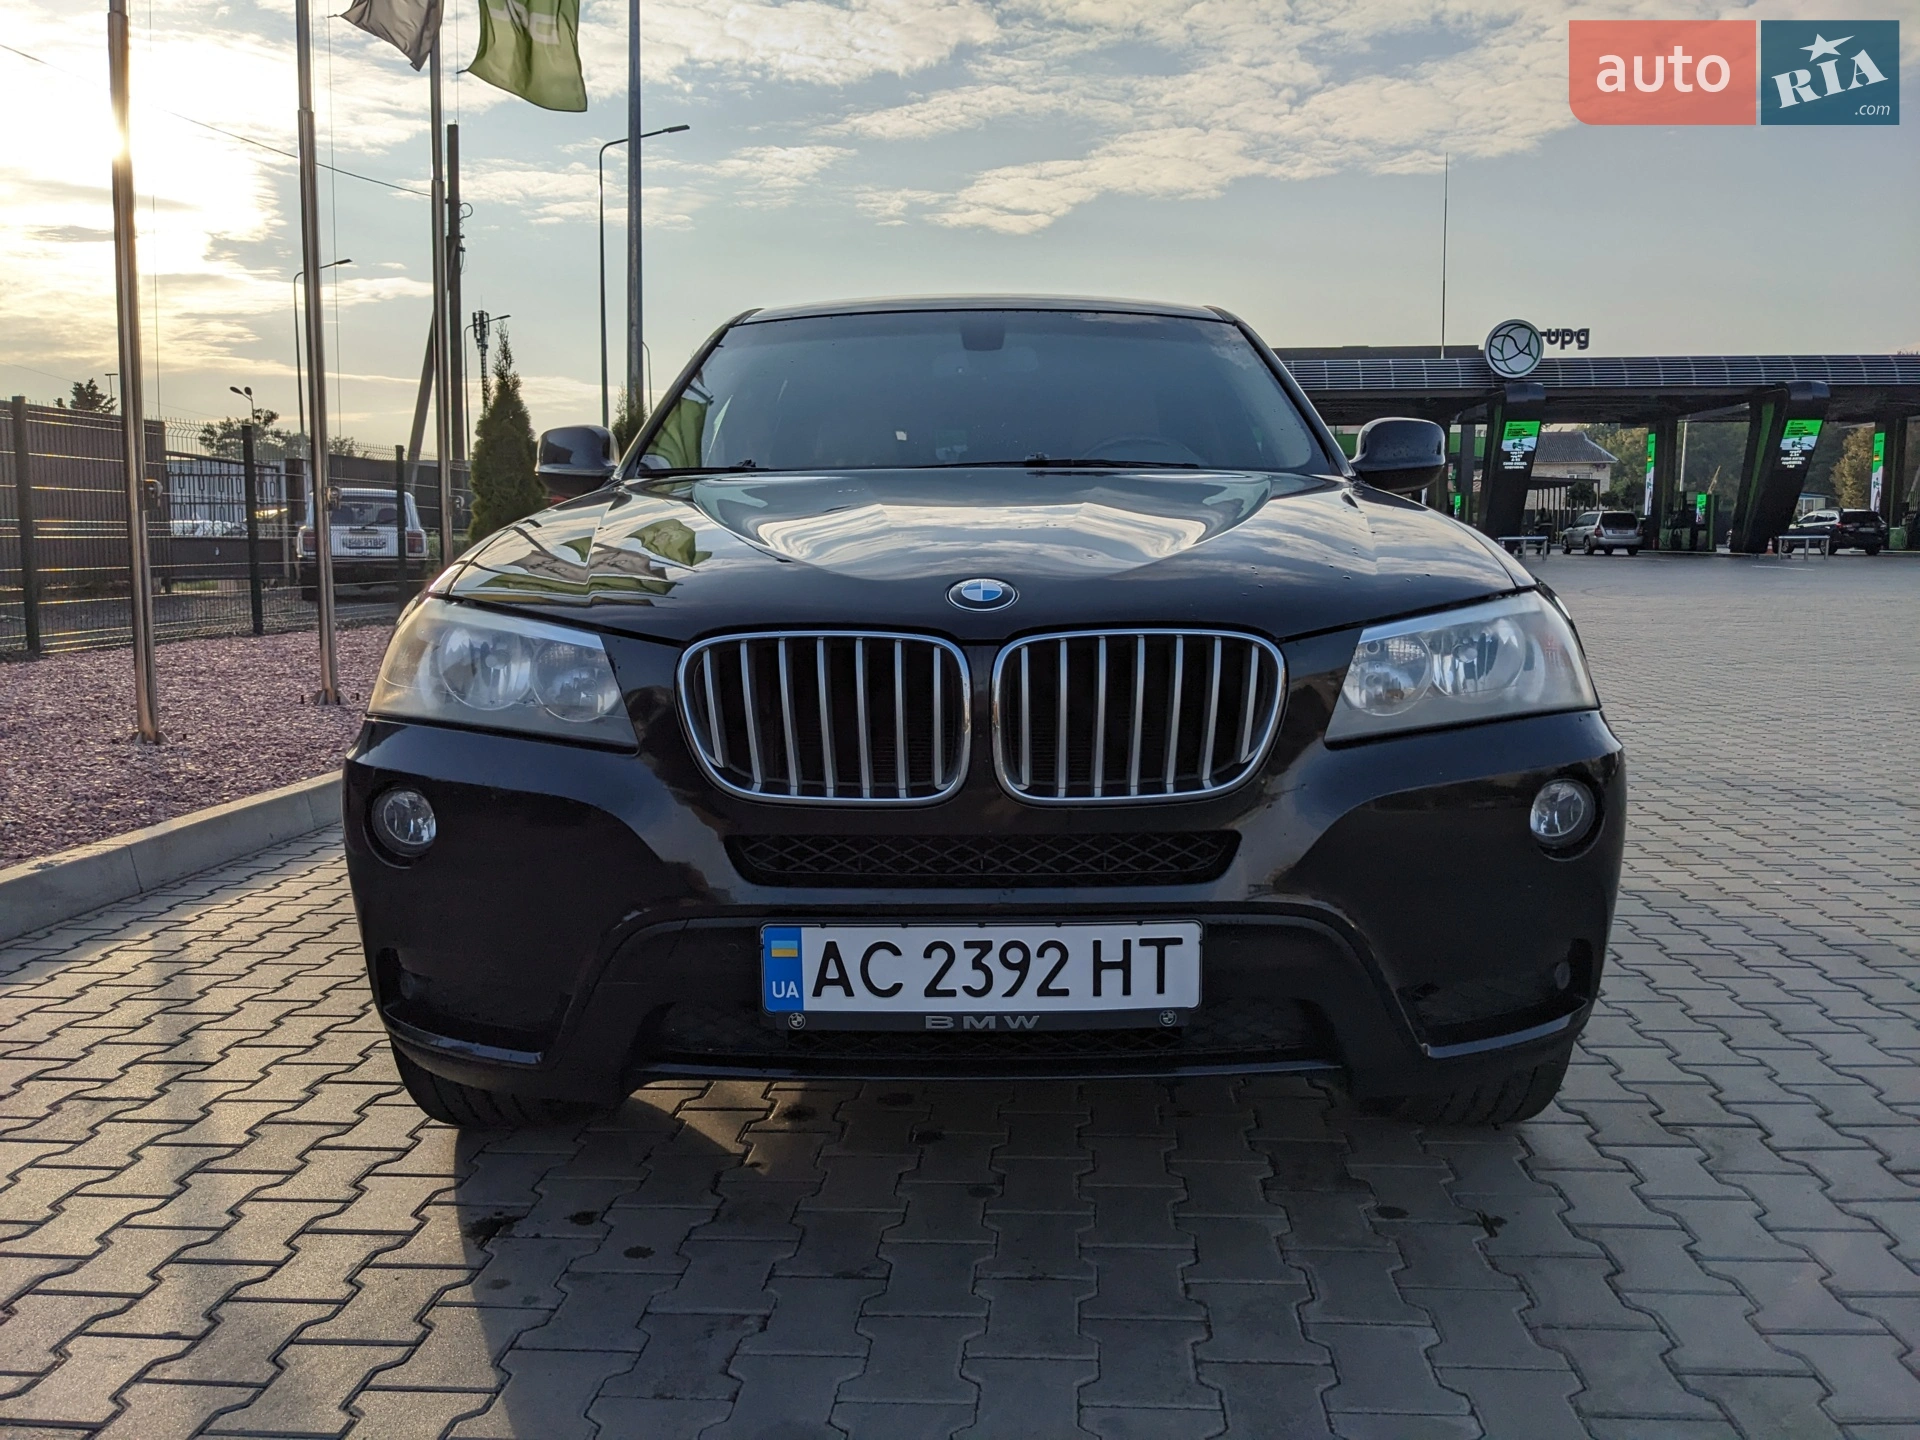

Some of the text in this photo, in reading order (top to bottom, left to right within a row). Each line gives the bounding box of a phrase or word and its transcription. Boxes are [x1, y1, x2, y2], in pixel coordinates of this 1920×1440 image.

[1546, 328, 1590, 350] upg
[812, 937, 1184, 998] AC 2392 HT
[772, 980, 800, 998] UA
[925, 1015, 1040, 1030] BMW
